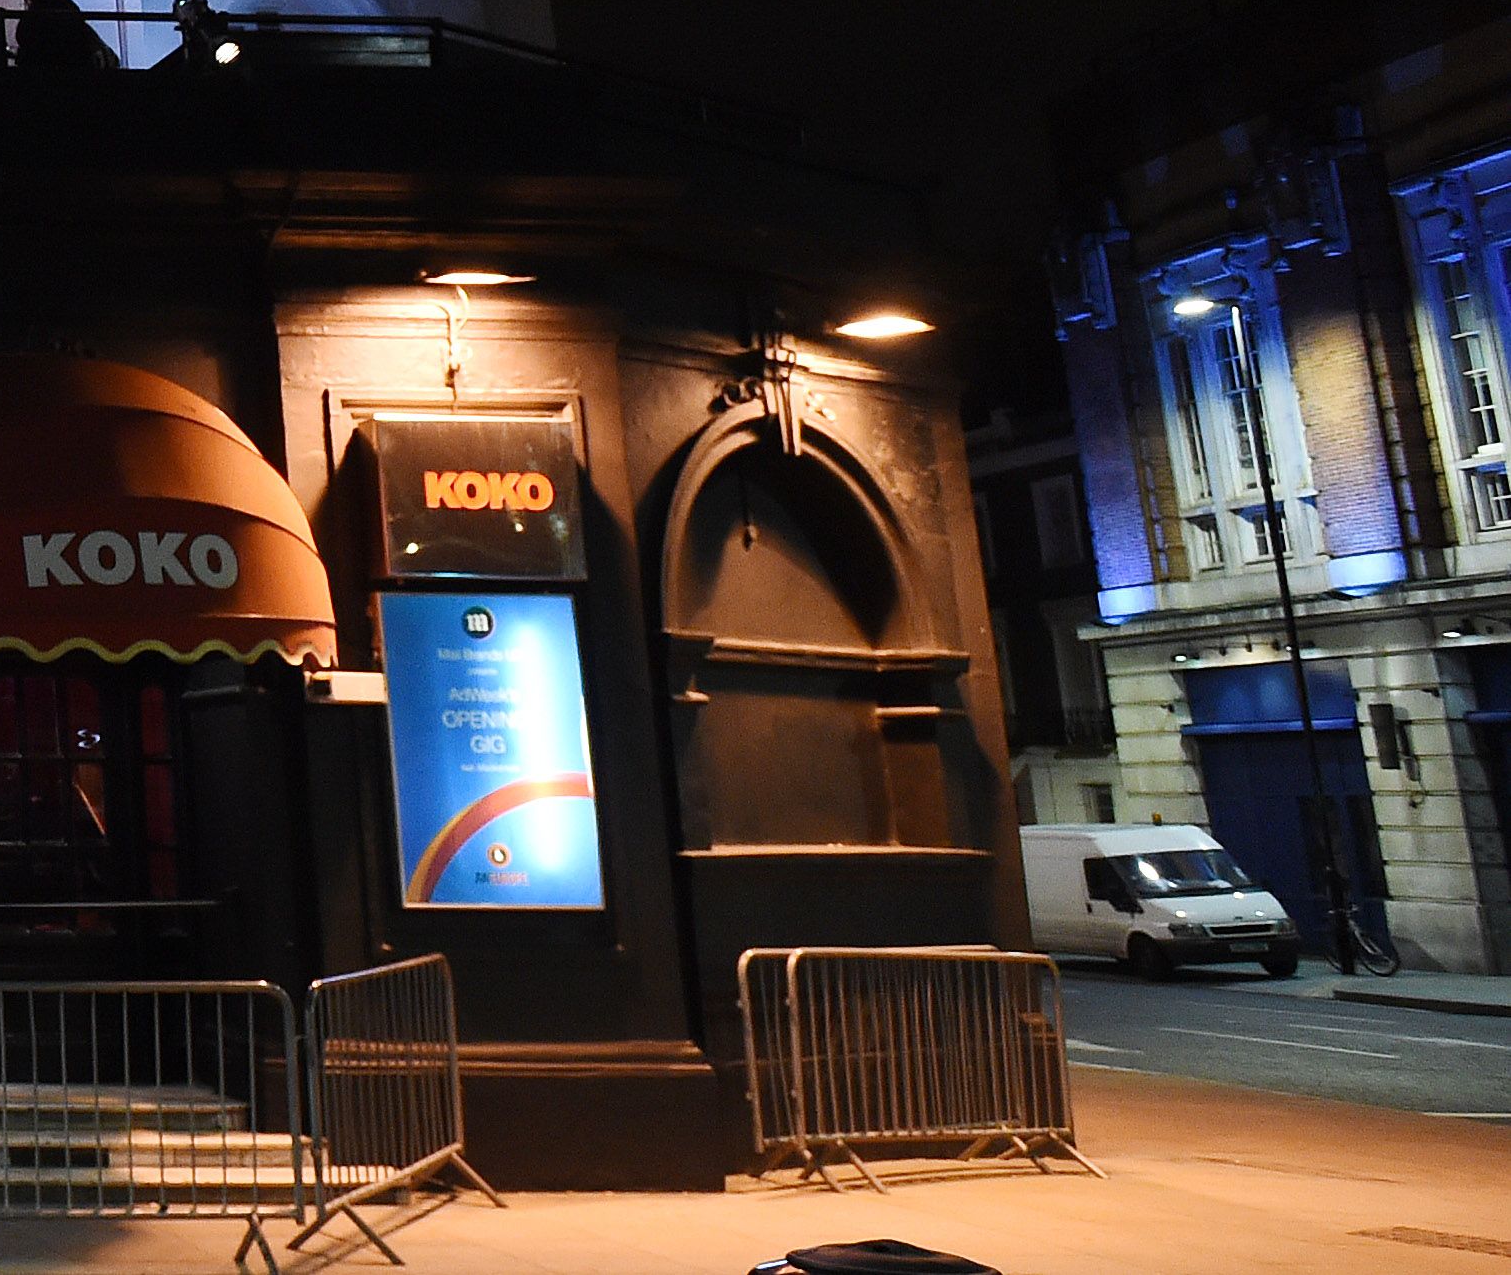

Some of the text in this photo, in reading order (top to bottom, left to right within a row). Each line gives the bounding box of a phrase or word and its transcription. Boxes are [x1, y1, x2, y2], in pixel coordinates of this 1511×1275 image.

[424, 471, 555, 511] KOKO
[22, 530, 239, 589] KOKO
[441, 709, 529, 728] OPENIN
[469, 734, 507, 755] GIG
